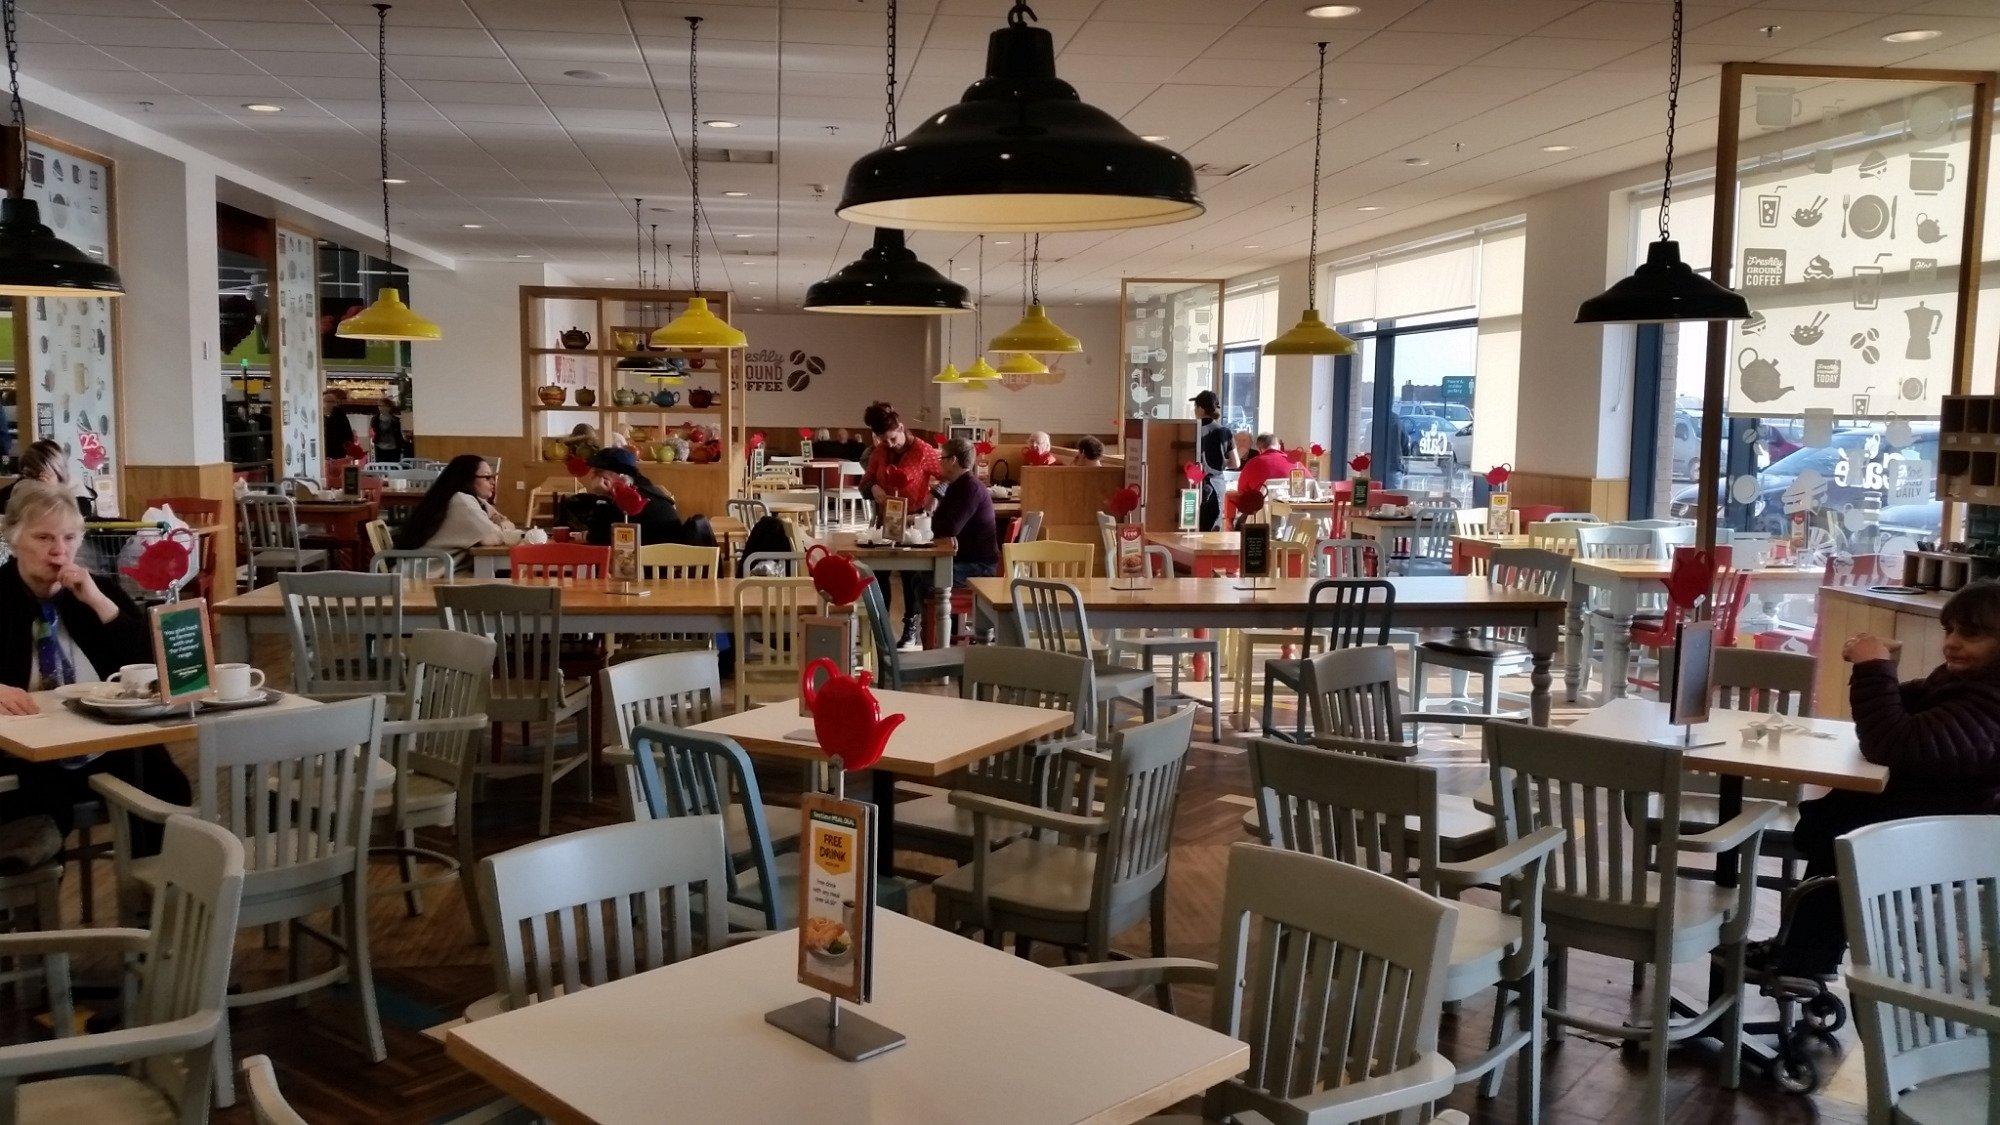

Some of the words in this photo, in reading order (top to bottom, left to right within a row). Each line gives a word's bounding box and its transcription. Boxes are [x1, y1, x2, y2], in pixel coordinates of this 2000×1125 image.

[1747, 255, 1783, 267] Freshly
[1746, 266, 1782, 274] GROUND
[1746, 274, 1781, 286] COFFEE
[1817, 374, 1838, 383] TODAY
[80, 434, 99, 449] 23
[824, 833, 843, 848] FREE
[820, 846, 847, 863] DRINK
